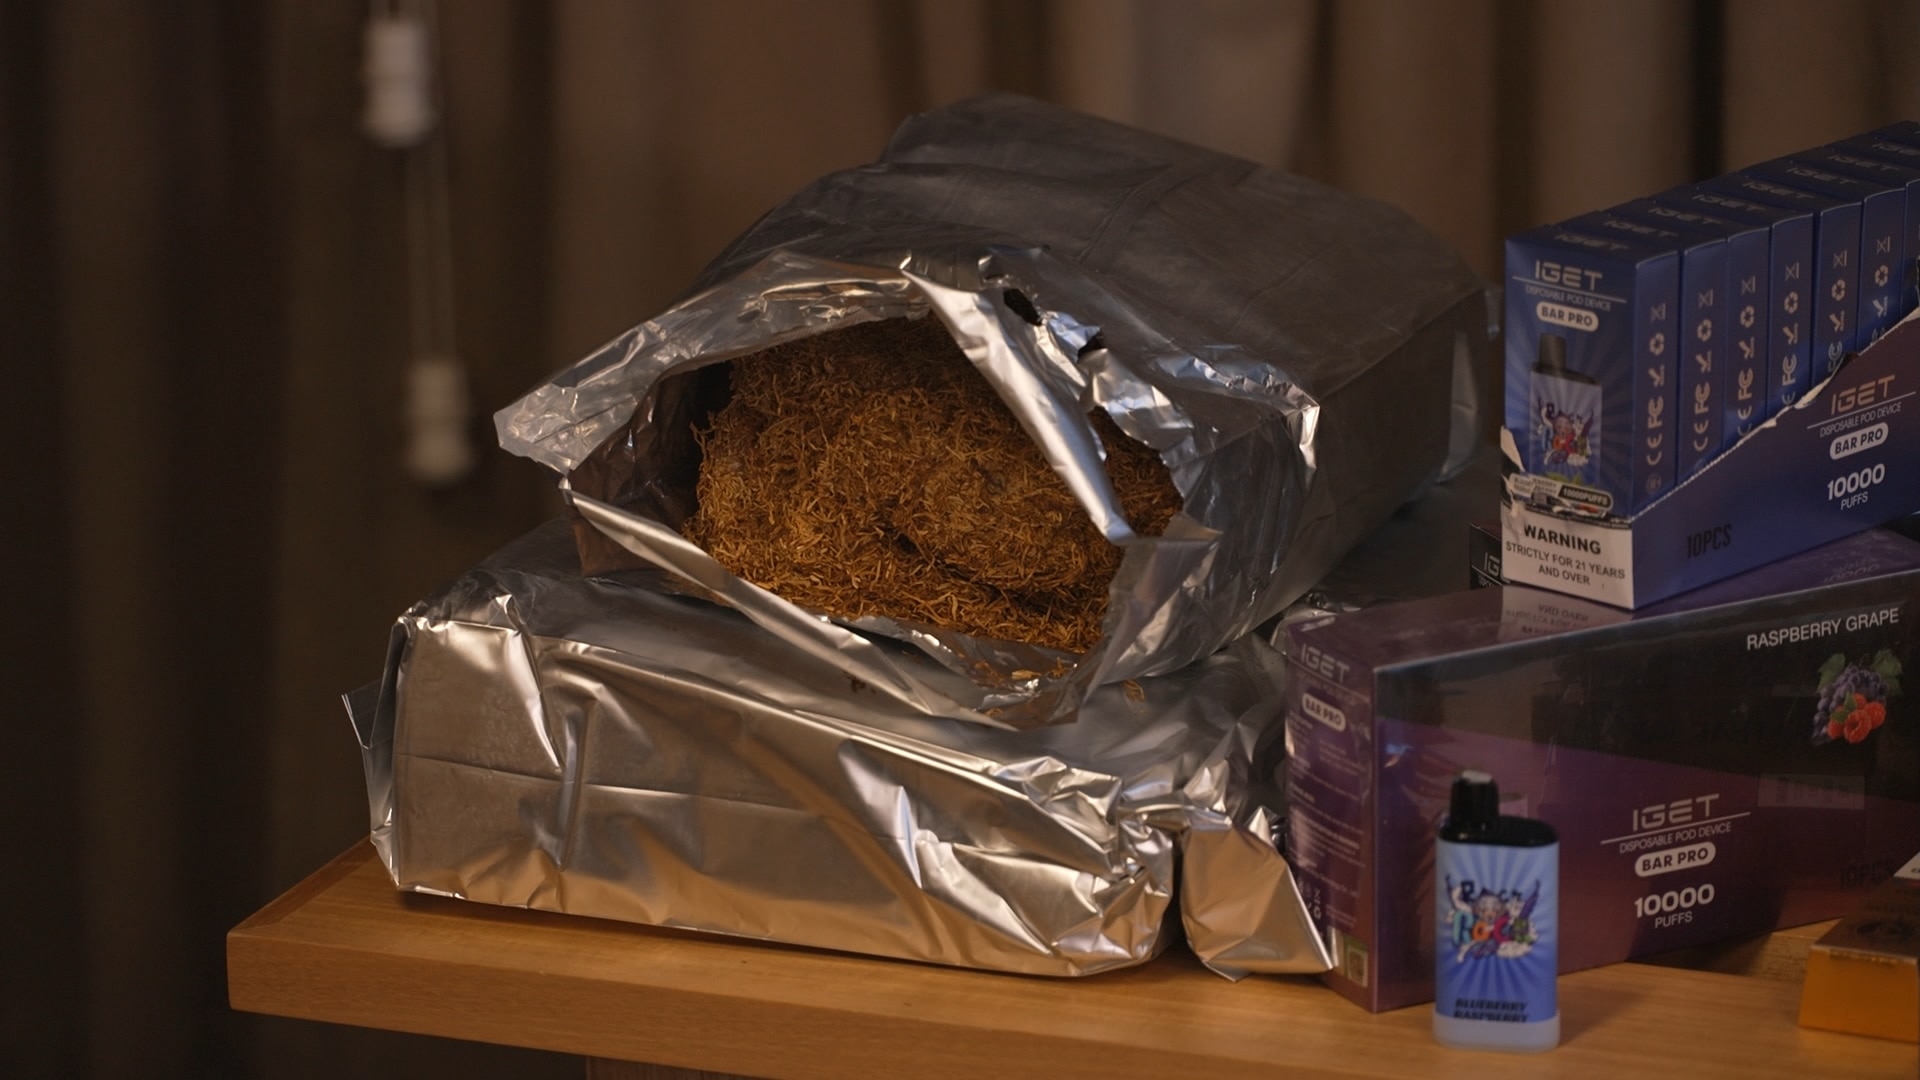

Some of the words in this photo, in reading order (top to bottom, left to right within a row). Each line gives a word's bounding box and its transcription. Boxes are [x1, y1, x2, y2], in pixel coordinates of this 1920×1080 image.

[1535, 259, 1604, 292] IGET
[1525, 283, 1565, 302] DISPOSABLE
[1567, 292, 1584, 306] POD
[1585, 297, 1611, 312] DEVICE
[1541, 305, 1565, 321] BAR
[1567, 311, 1593, 327] PRO
[1831, 374, 1896, 416] IGET
[1820, 416, 1860, 438] DISPOSABLE
[1860, 410, 1877, 425] POD
[1877, 402, 1902, 419] DEVICE
[1834, 436, 1858, 455] BAR
[1860, 427, 1884, 447] PRO
[1827, 463, 1886, 501] 10000
[1840, 491, 1869, 510] PUFFS
[1524, 524, 1602, 555] WARNING
[1686, 523, 1733, 559] 10PCS
[1483, 551, 1501, 578] IG
[1505, 541, 1550, 562] STRICTLY
[1552, 554, 1573, 569] FOR
[1575, 559, 1587, 571] 21
[1588, 563, 1626, 580] YEARS
[1538, 564, 1560, 578] AND
[1562, 571, 1591, 586] OVER
[1747, 618, 1842, 651] RASPBERRY
[1846, 608, 1900, 632] GRAPE
[1301, 643, 1351, 683] IGET
[1305, 697, 1321, 716] BAR
[1322, 708, 1342, 726] PRO
[1632, 793, 1720, 832] IGET
[1619, 832, 1673, 854] DISPOSABLE
[1675, 829, 1697, 843] POD
[1698, 821, 1732, 839] DEVICE
[1642, 854, 1673, 872] BAR
[1677, 847, 1709, 865] PRO
[1634, 883, 1716, 918] 10000
[1655, 911, 1694, 929] PUFFS
[1453, 1008, 1531, 1024] RASPBERRY
[1455, 997, 1529, 1013] BLUEBERRY
